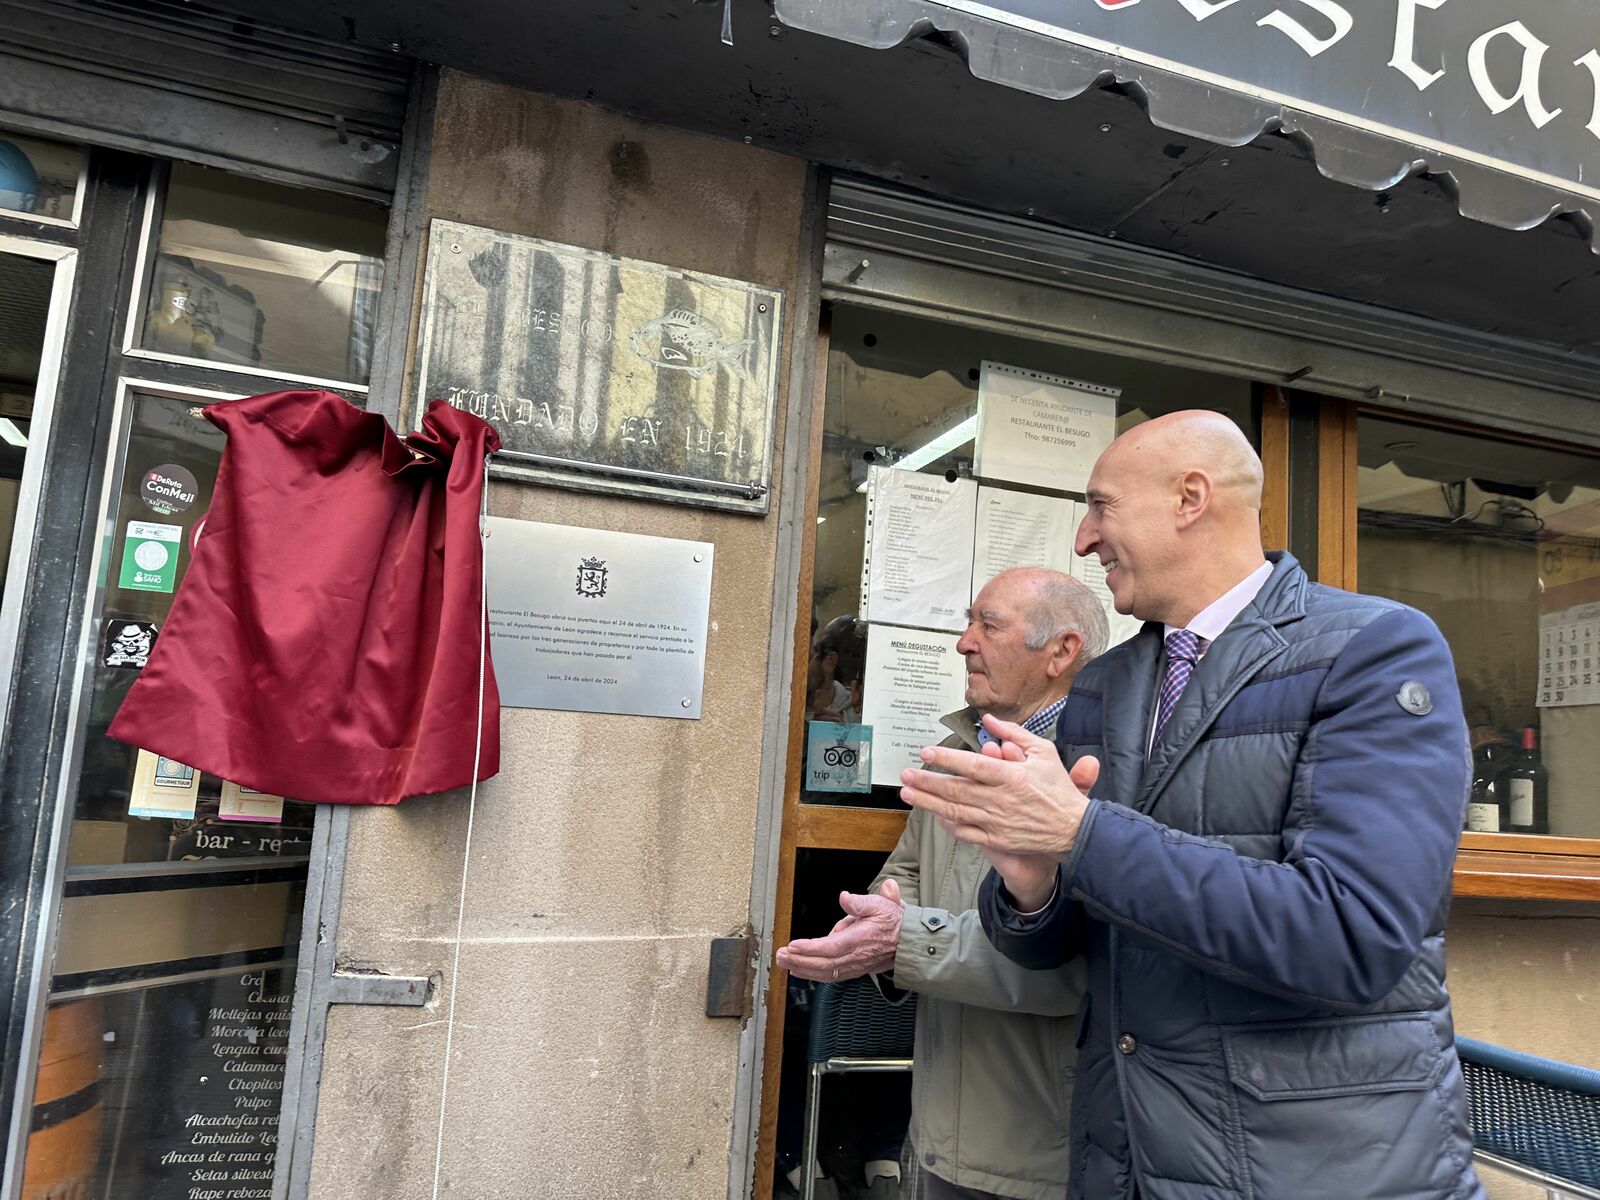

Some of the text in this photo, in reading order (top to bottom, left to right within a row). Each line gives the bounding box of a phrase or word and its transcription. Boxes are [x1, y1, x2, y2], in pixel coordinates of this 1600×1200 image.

[1010, 417, 1091, 438] RESTAURANTE EL BESUGO
[489, 608, 522, 616] restaurante
[530, 612, 551, 620] Besugo
[513, 622, 553, 631] Ayuntamiento
[576, 628, 602, 636] agradece
[659, 635, 682, 643] prestado
[535, 647, 570, 655] trabajadores
[552, 637, 590, 645] generaciones
[598, 641, 631, 650] propietarios
[665, 646, 687, 654] plantilla
[890, 640, 947, 653] MENÚ DEGUSTACIÓN
[195, 830, 235, 850] bar
[208, 1007, 262, 1023] Mollejas
[211, 1043, 259, 1058] Lengua
[228, 1077, 282, 1093] Chopitos
[234, 1095, 272, 1111] Pulpo
[184, 1113, 259, 1129] Alcachofas
[191, 1131, 255, 1145] Embutido
[161, 1150, 205, 1165] Ancas
[208, 1150, 226, 1162] de
[227, 1152, 262, 1162] rana
[187, 1186, 224, 1200] Rape
